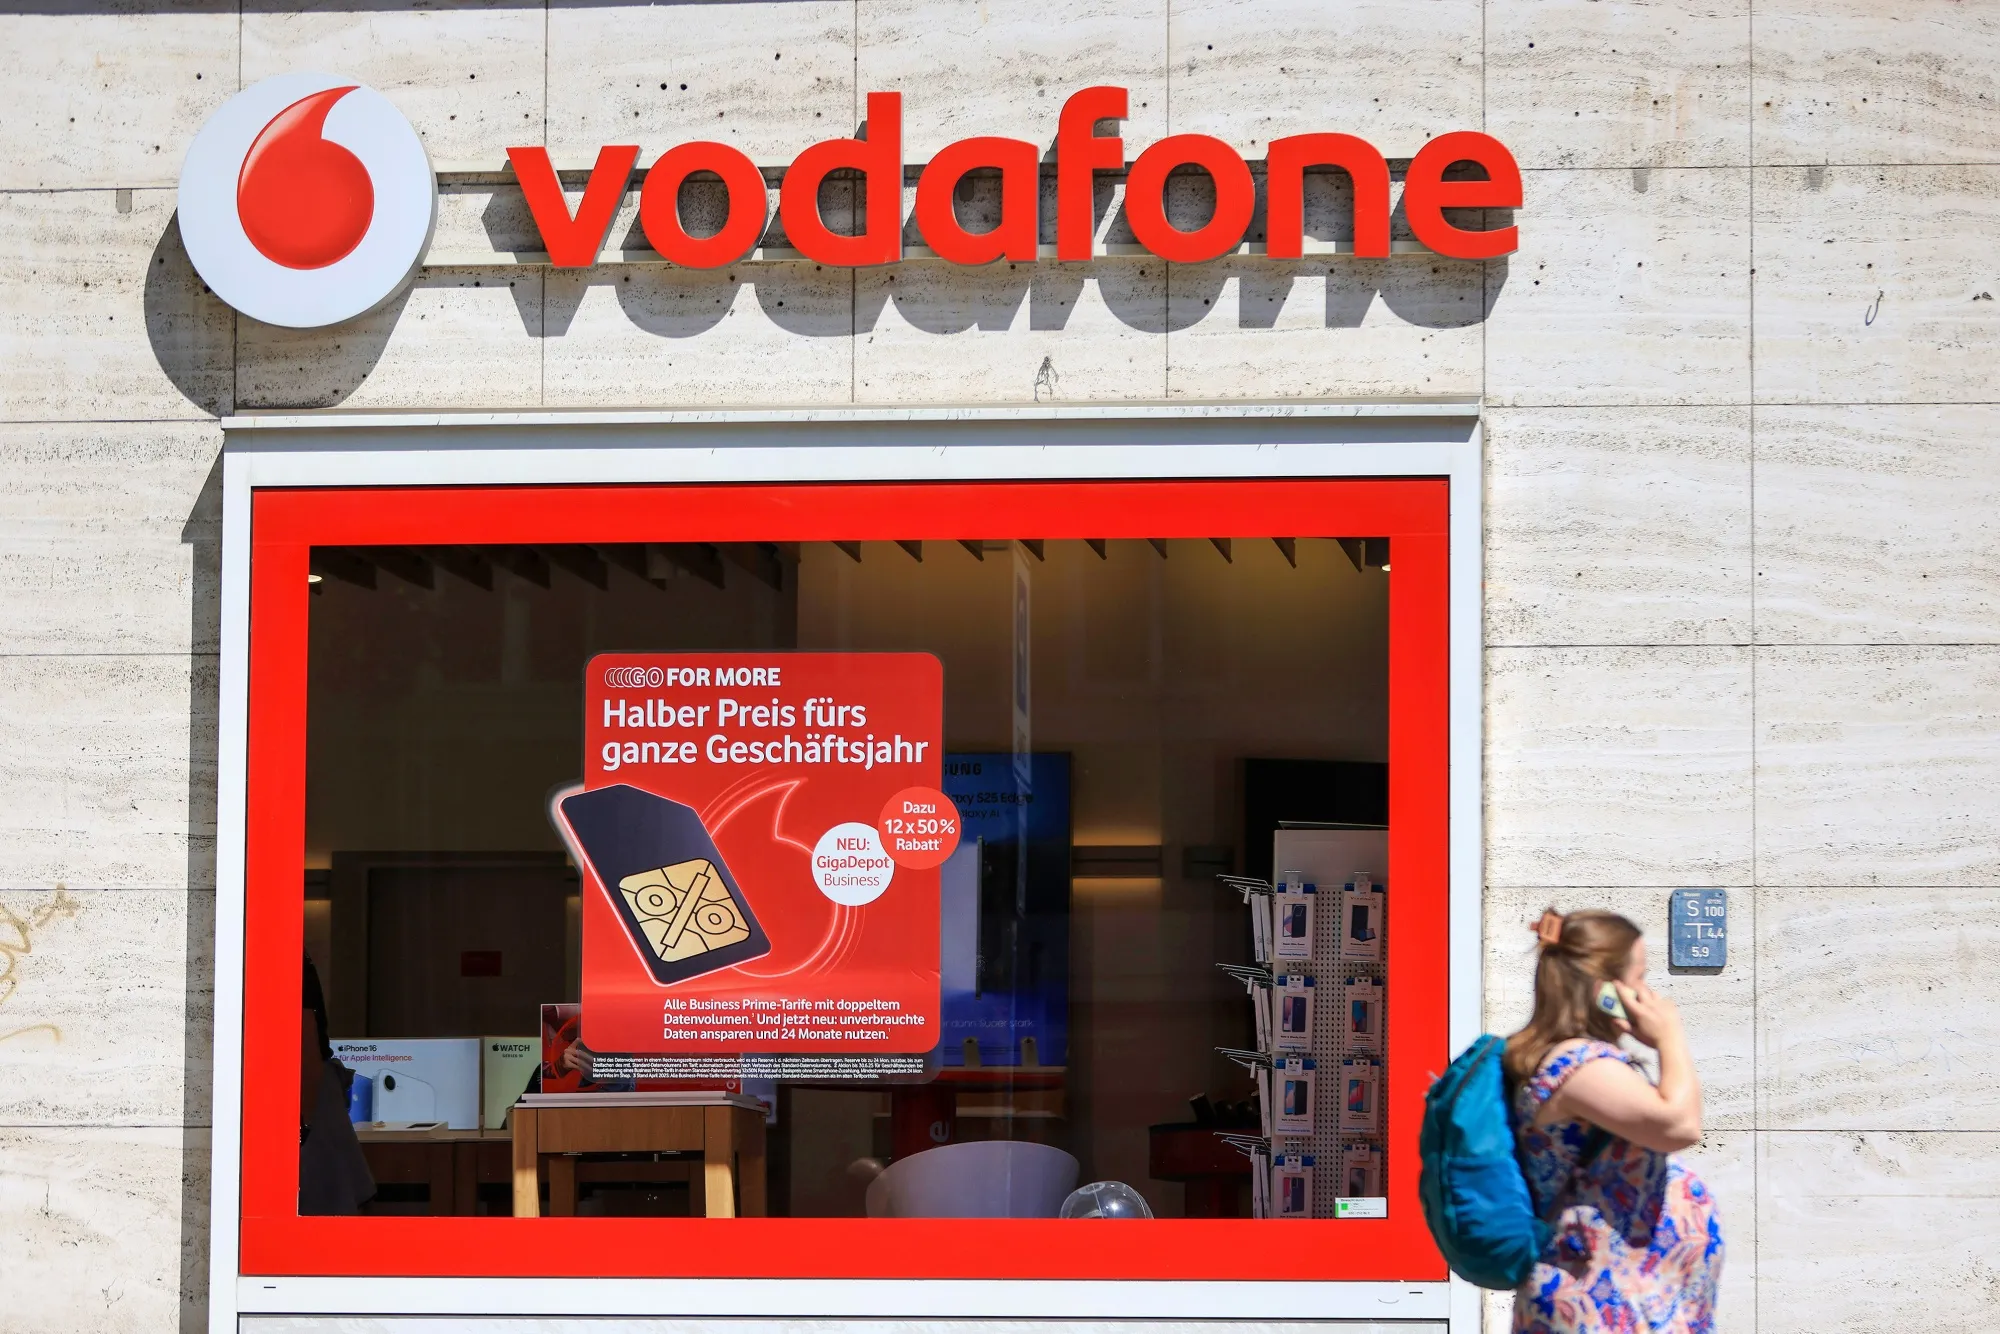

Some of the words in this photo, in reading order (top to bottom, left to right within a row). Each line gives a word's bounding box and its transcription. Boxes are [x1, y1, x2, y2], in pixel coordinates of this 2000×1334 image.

[507, 86, 1523, 268] vodafone
[667, 668, 710, 687] FOR
[716, 668, 781, 687] MORE
[604, 699, 710, 728] Halber
[719, 698, 795, 728] Preis
[804, 698, 867, 727] fürs
[602, 742, 697, 771] ganze
[707, 733, 929, 770] Geschäftsjahr
[904, 801, 936, 814] Dazu
[837, 838, 870, 851] NEU:
[817, 855, 890, 872] GigaDepot
[1687, 900, 1700, 917] S
[1704, 906, 1725, 917] 100
[664, 999, 687, 1010] Alle
[690, 999, 740, 1010] Business
[743, 999, 812, 1010] Prime-Tarife
[815, 999, 834, 1010] mit
[837, 999, 900, 1012] doppeltem
[757, 1014, 781, 1025] Und
[783, 1014, 810, 1027] jetzt
[813, 1015, 838, 1025] neu:
[840, 1014, 925, 1025] unverbrauchte
[664, 1028, 697, 1040] Daten
[700, 1029, 754, 1042] ansparen
[756, 1028, 778, 1040] und
[781, 1028, 796, 1040] 24
[799, 1028, 842, 1040] Monate
[500, 1044, 530, 1052] WATCH
[350, 1054, 371, 1063] Apple
